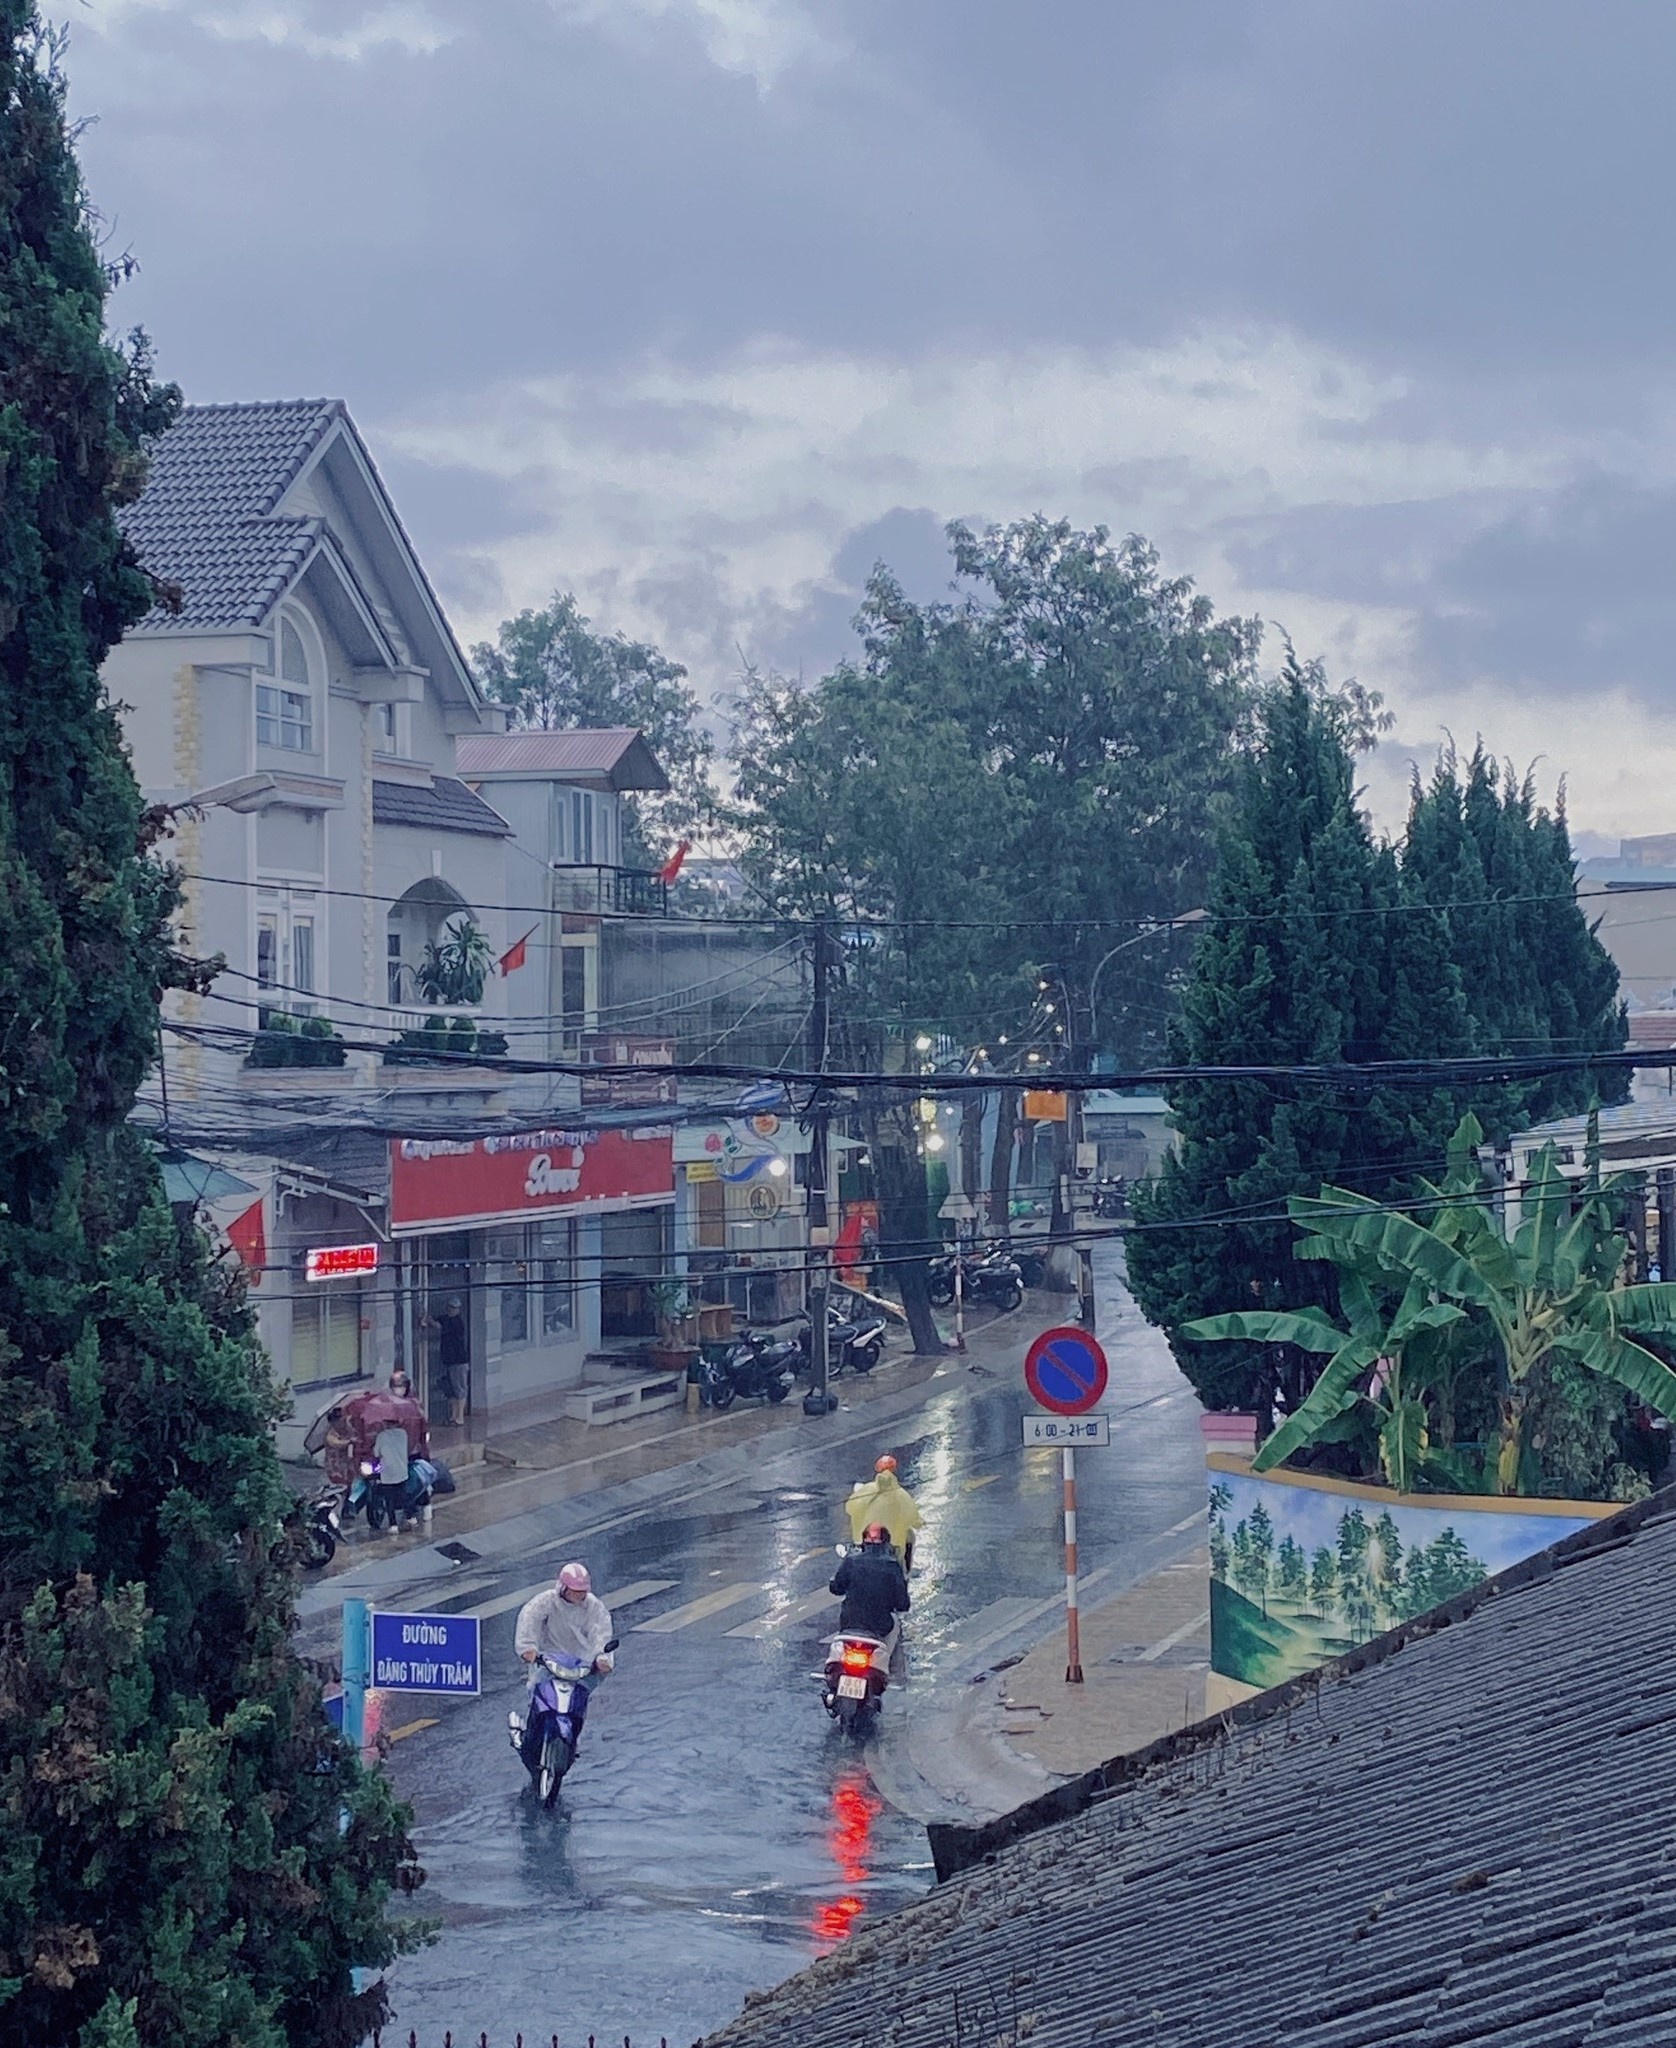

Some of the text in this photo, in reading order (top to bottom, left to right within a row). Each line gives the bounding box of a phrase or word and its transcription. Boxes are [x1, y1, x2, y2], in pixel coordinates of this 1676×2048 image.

[402, 1621, 447, 1645] ĐƯỜNG
[377, 1657, 472, 1686] ĐẶNG THÙY TRÂM
